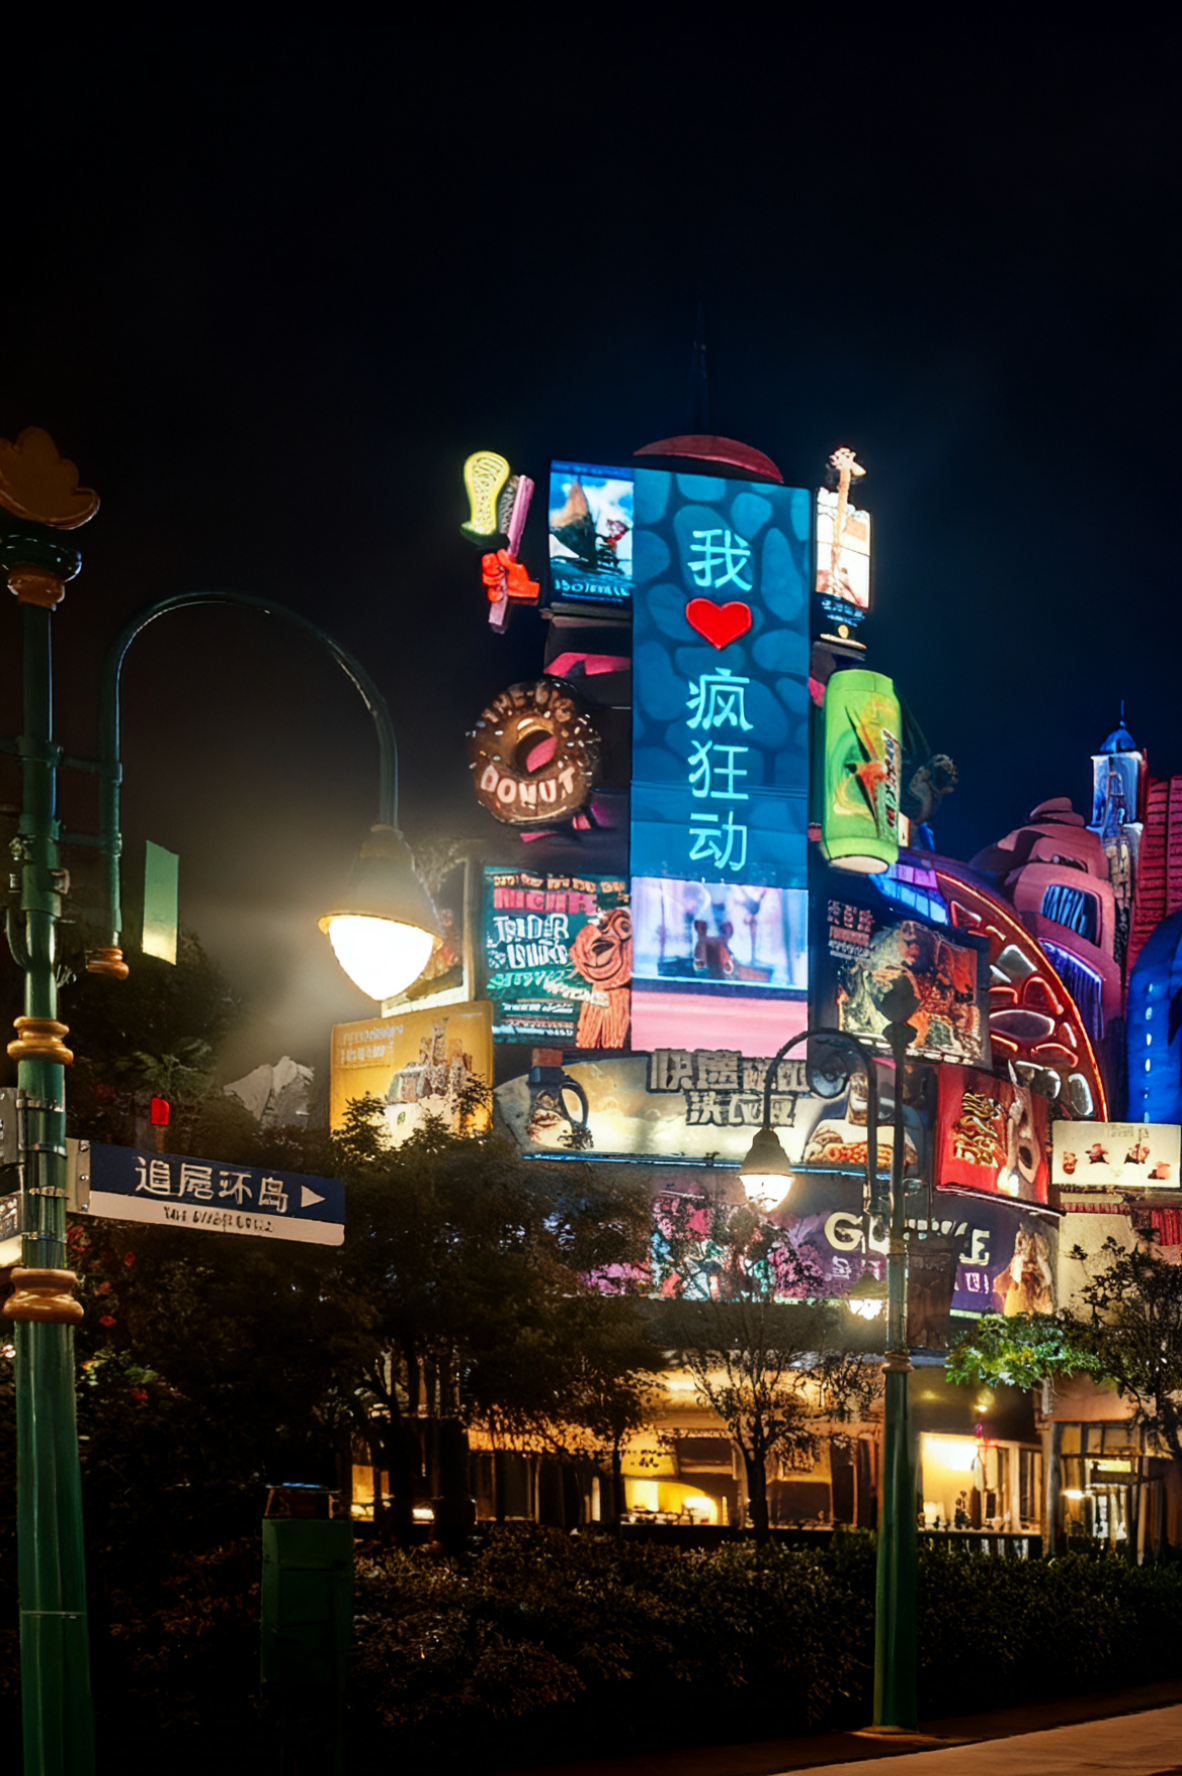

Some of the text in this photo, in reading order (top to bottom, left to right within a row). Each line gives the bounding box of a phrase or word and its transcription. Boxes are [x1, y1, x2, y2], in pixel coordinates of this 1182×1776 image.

[480, 765, 575, 804] DONUT
[686, 529, 754, 872] 我 疯狂动
